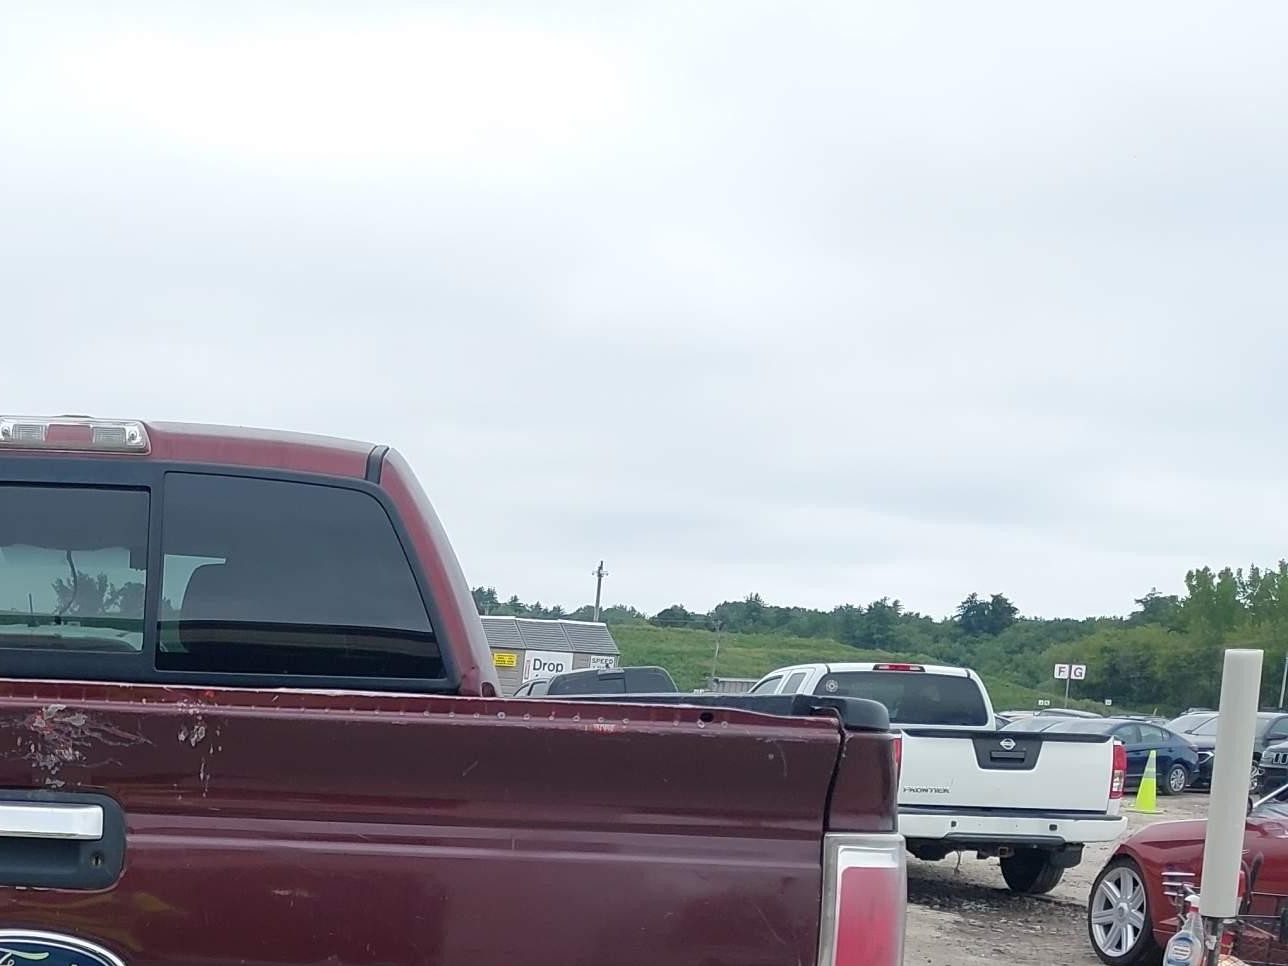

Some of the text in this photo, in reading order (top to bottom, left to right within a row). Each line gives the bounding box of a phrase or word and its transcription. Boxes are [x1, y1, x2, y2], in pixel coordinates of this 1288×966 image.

[533, 658, 564, 673] Drop
[1058, 666, 1066, 677] F
[1073, 667, 1083, 678] G
